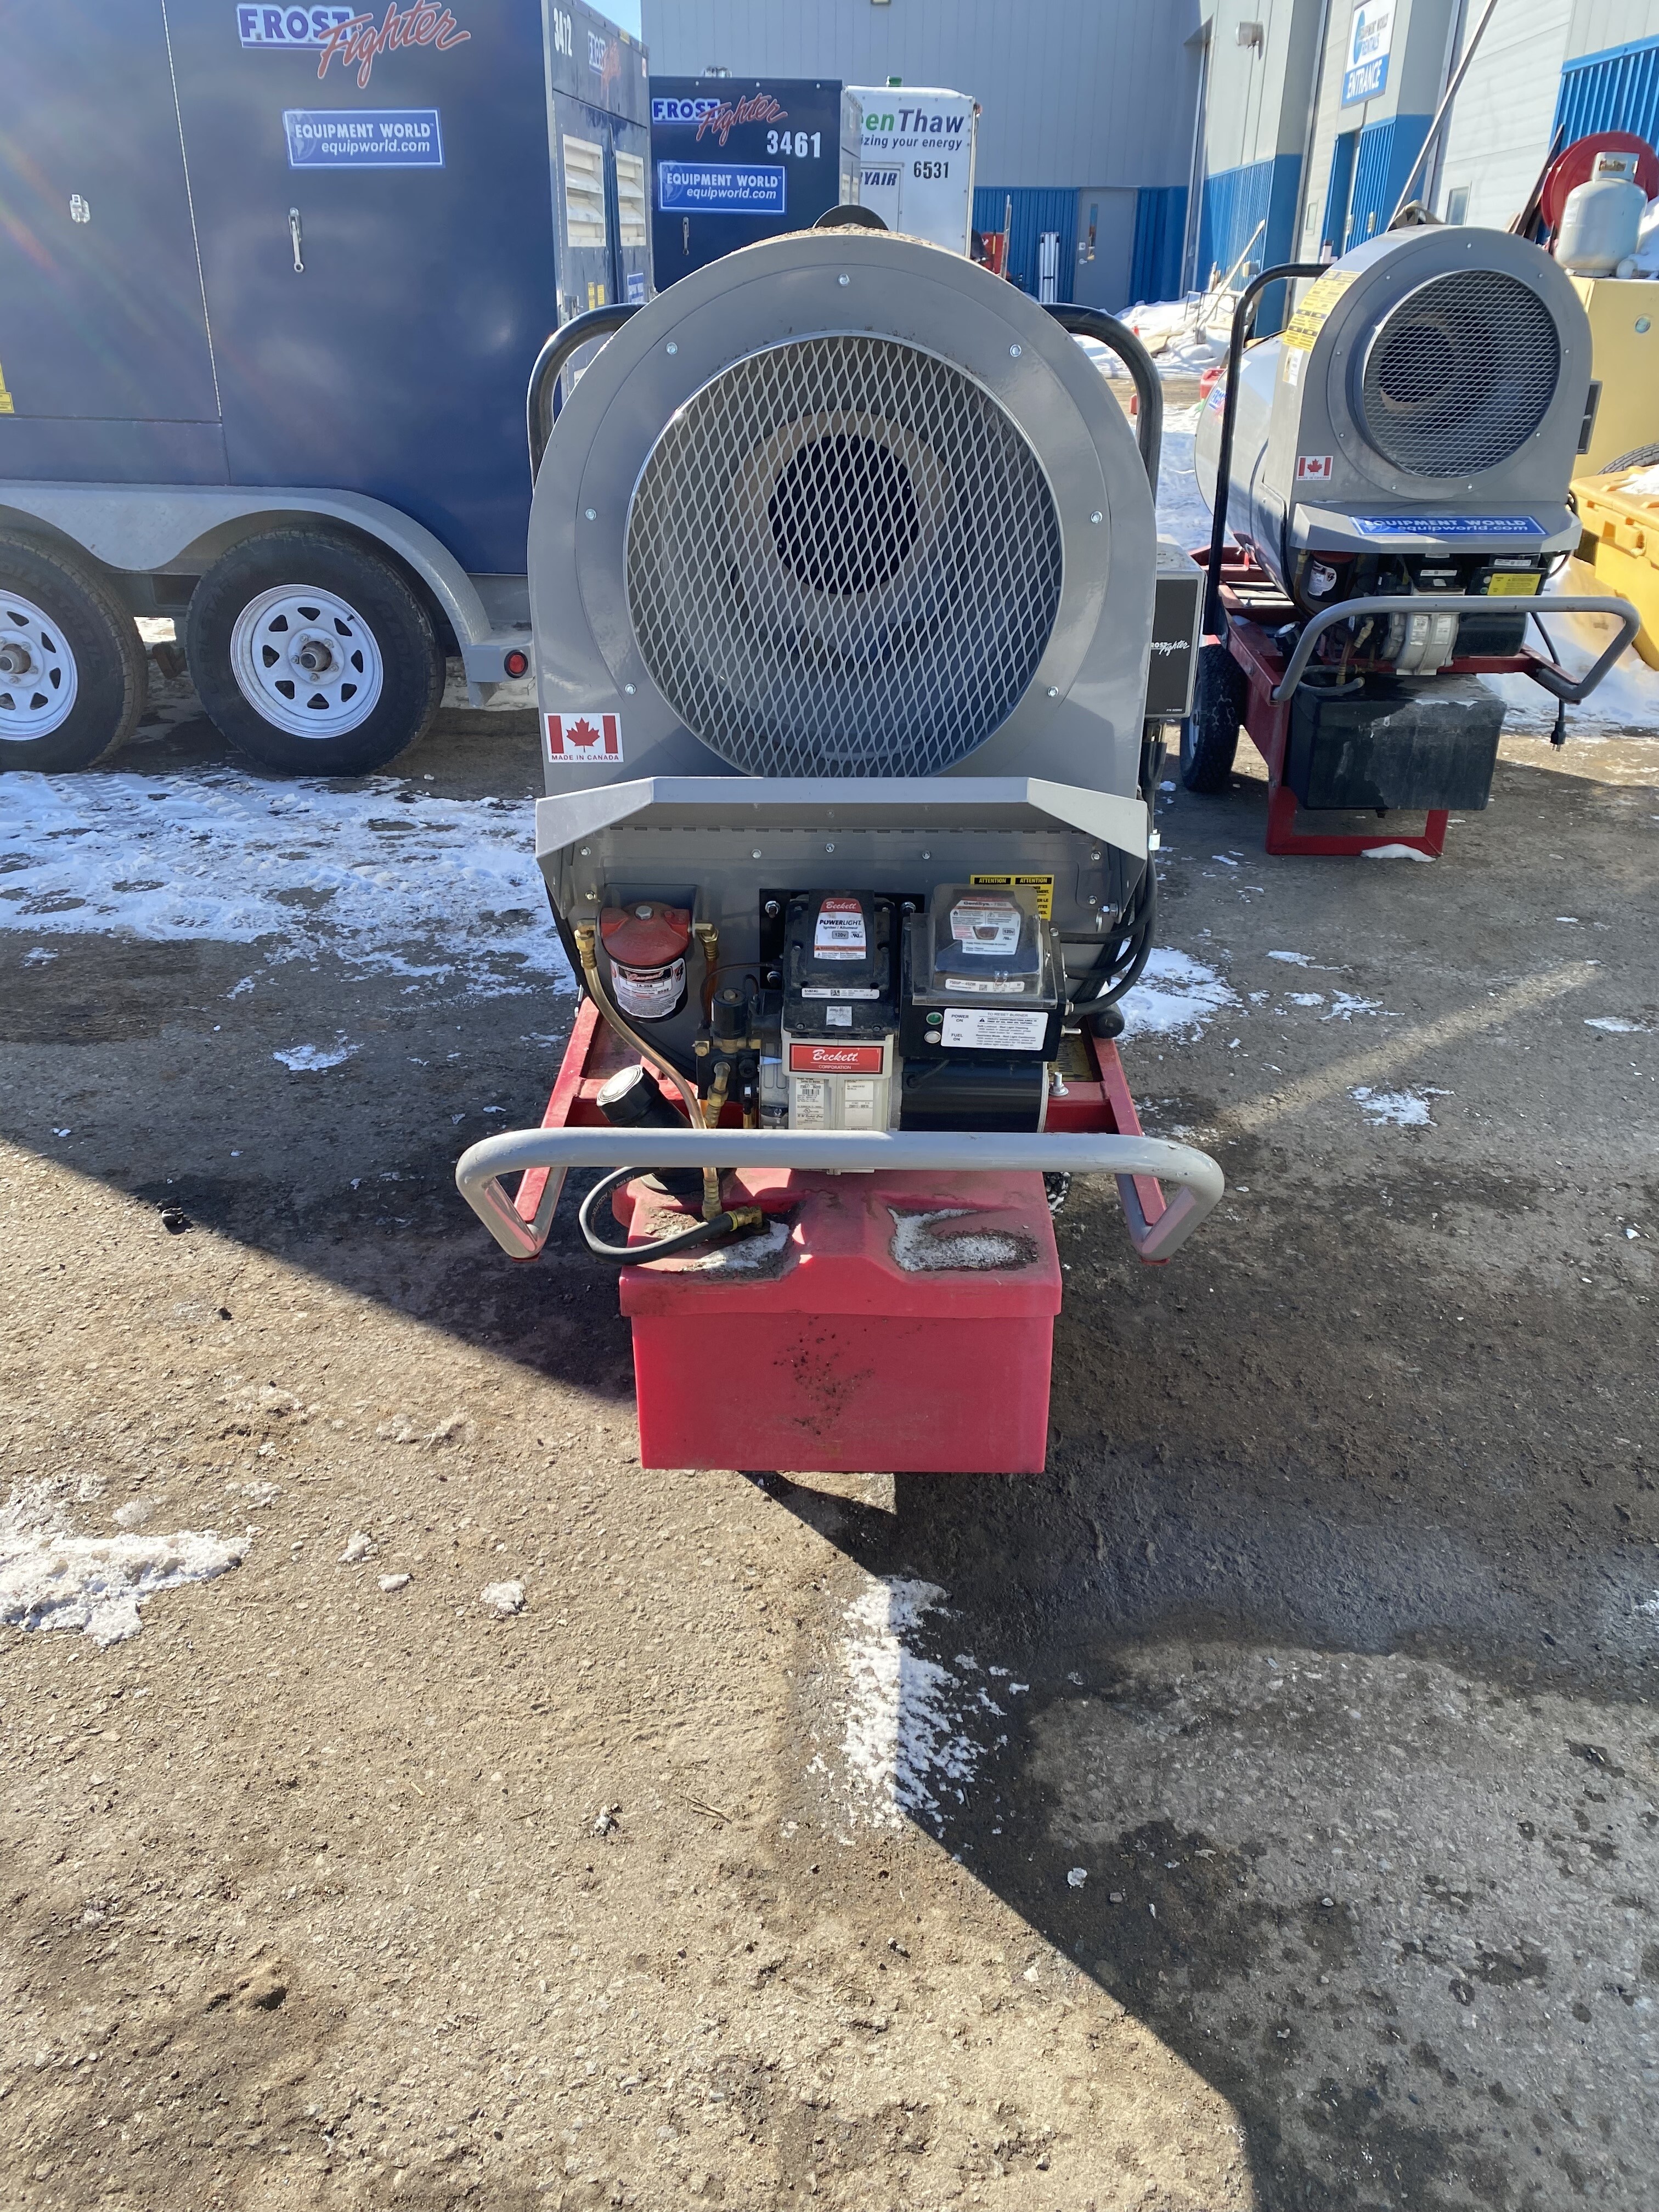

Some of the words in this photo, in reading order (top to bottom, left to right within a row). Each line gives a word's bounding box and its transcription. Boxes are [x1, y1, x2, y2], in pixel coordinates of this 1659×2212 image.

[237, 5, 352, 41] FROST
[317, 0, 471, 88] Fighter
[1346, 59, 1383, 99] ENTRANCE
[653, 100, 719, 119] FROST
[696, 92, 788, 146] Fighter
[295, 123, 374, 138] EQUIPMENT
[380, 123, 431, 138] WORLD
[321, 139, 430, 155] equipworld.com
[766, 130, 821, 158] 3461
[892, 138, 918, 149] your
[922, 139, 962, 151] energy
[913, 160, 949, 179] 6531
[667, 173, 732, 187] EQUIPMENT
[737, 174, 778, 188] WORLD
[687, 187, 776, 200] equipworld.com
[1158, 640, 1190, 656] Fighter
[826, 901, 856, 909] Beckett
[812, 1049, 859, 1062] Beckett
